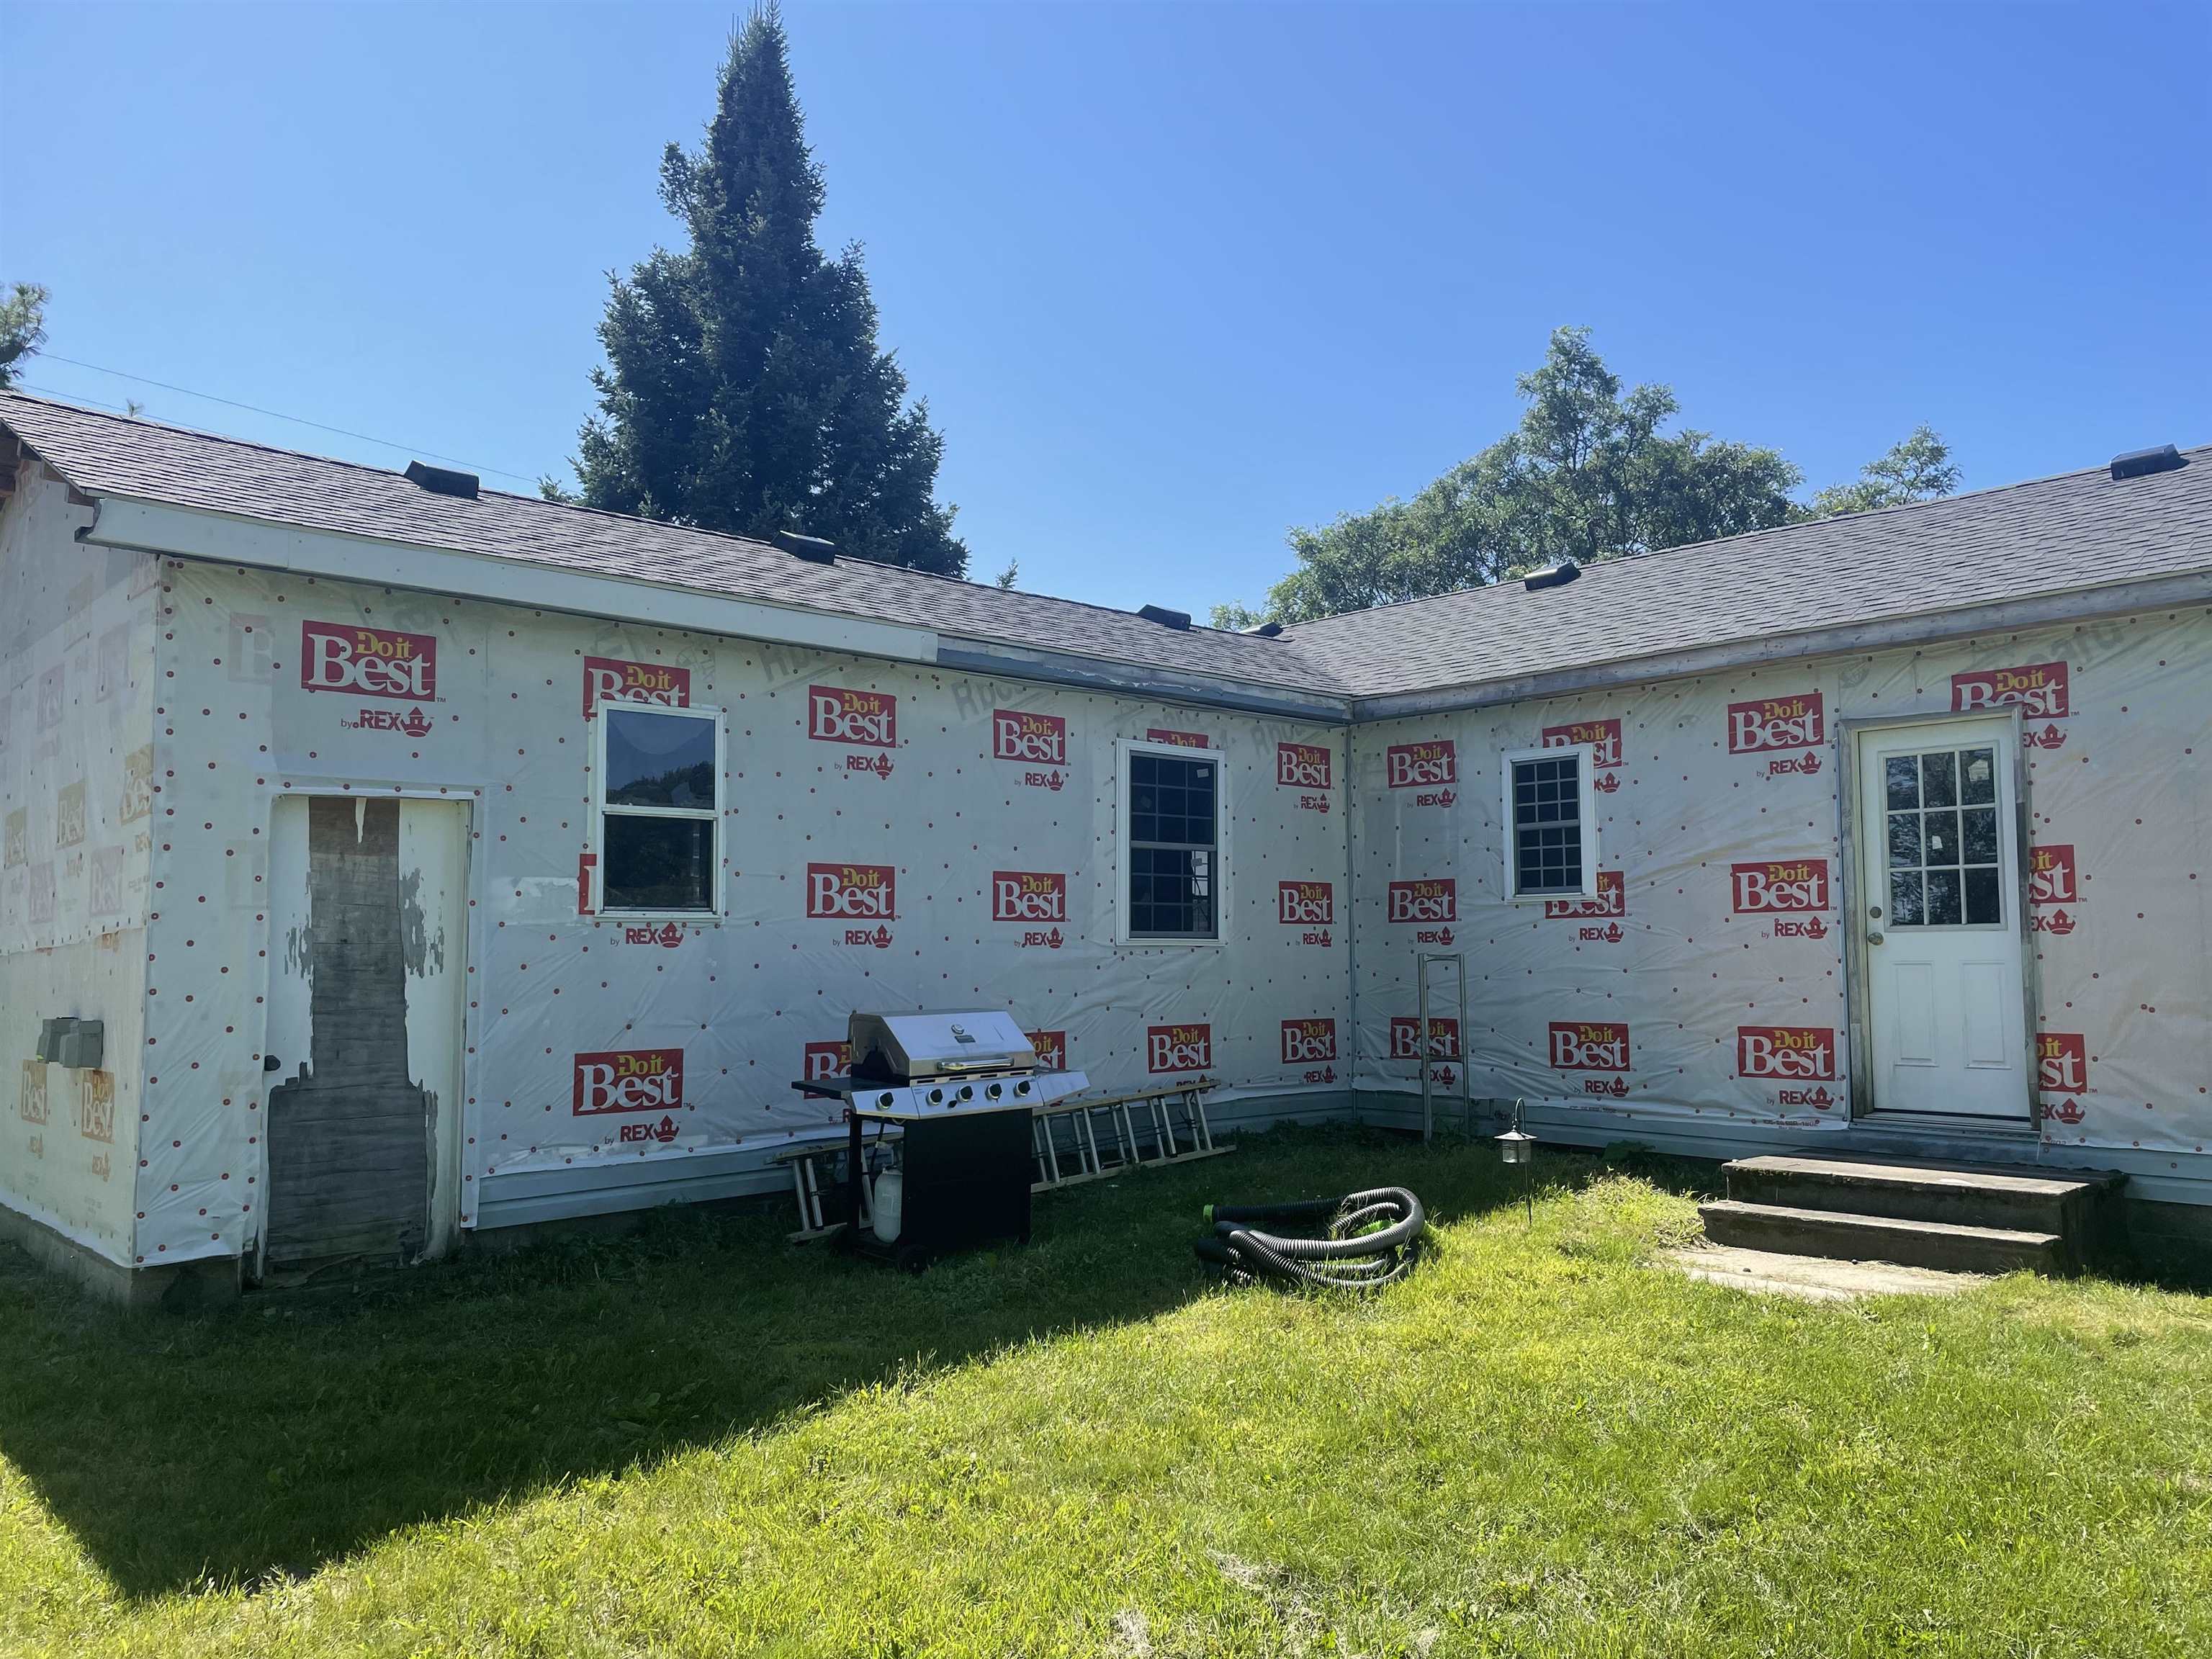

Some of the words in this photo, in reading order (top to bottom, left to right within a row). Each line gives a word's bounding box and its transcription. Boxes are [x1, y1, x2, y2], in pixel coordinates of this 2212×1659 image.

[307, 633, 431, 696] Best
[341, 719, 351, 729] by
[360, 709, 401, 731] REX
[812, 696, 892, 743] Best
[1732, 709, 1820, 750] Best
[997, 719, 1063, 761] Best
[847, 755, 874, 771] REX
[1280, 750, 1328, 786] Best
[1390, 752, 1453, 786] Best
[1770, 759, 1799, 775] REX
[1025, 773, 1047, 787] REX
[1301, 796, 1318, 809] REX
[1417, 794, 1438, 806] REX
[811, 873, 892, 915] Best
[1736, 872, 1825, 910] Best
[2031, 861, 2072, 899] st
[996, 881, 1063, 918] Best
[1281, 889, 1331, 921] Best
[1391, 889, 1453, 920] Best
[611, 938, 619, 946] by
[626, 928, 658, 945] REX
[845, 930, 873, 945] REX
[1025, 932, 1047, 945] REX
[1303, 933, 1319, 945] REX
[1417, 931, 1439, 943] REX
[1580, 927, 1604, 940] REX
[1775, 922, 1804, 937] REX
[1151, 1035, 1208, 1070] Best
[1283, 1028, 1334, 1061] Best
[1552, 1030, 1627, 1068] Best
[1742, 1035, 1831, 1077] Best
[1306, 1071, 1323, 1083] REX
[2040, 1051, 2082, 1088] st
[578, 1064, 679, 1111] Best
[1585, 1080, 1609, 1094] REX
[1779, 1090, 1810, 1105] REX
[84, 1082, 113, 1138] Best
[605, 1136, 614, 1146] by
[620, 1124, 654, 1143] REX
